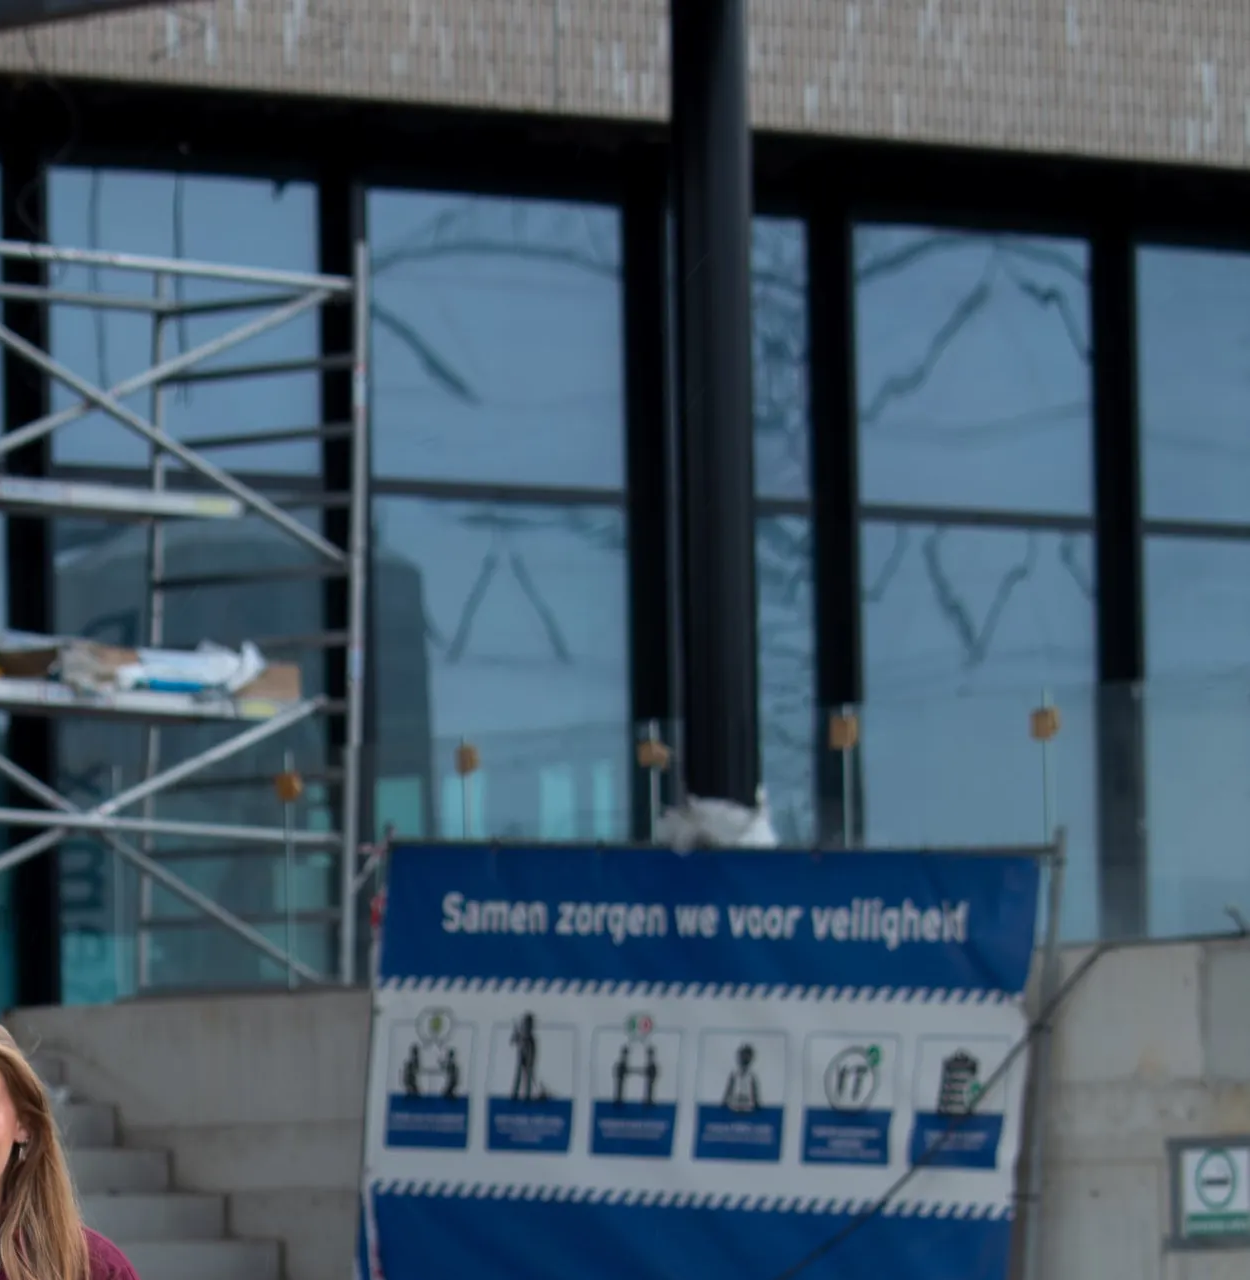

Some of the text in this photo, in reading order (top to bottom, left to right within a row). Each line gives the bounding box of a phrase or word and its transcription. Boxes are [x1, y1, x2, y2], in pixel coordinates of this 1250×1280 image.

[442, 893, 968, 950] Samen zorgen we voor veiligheid
